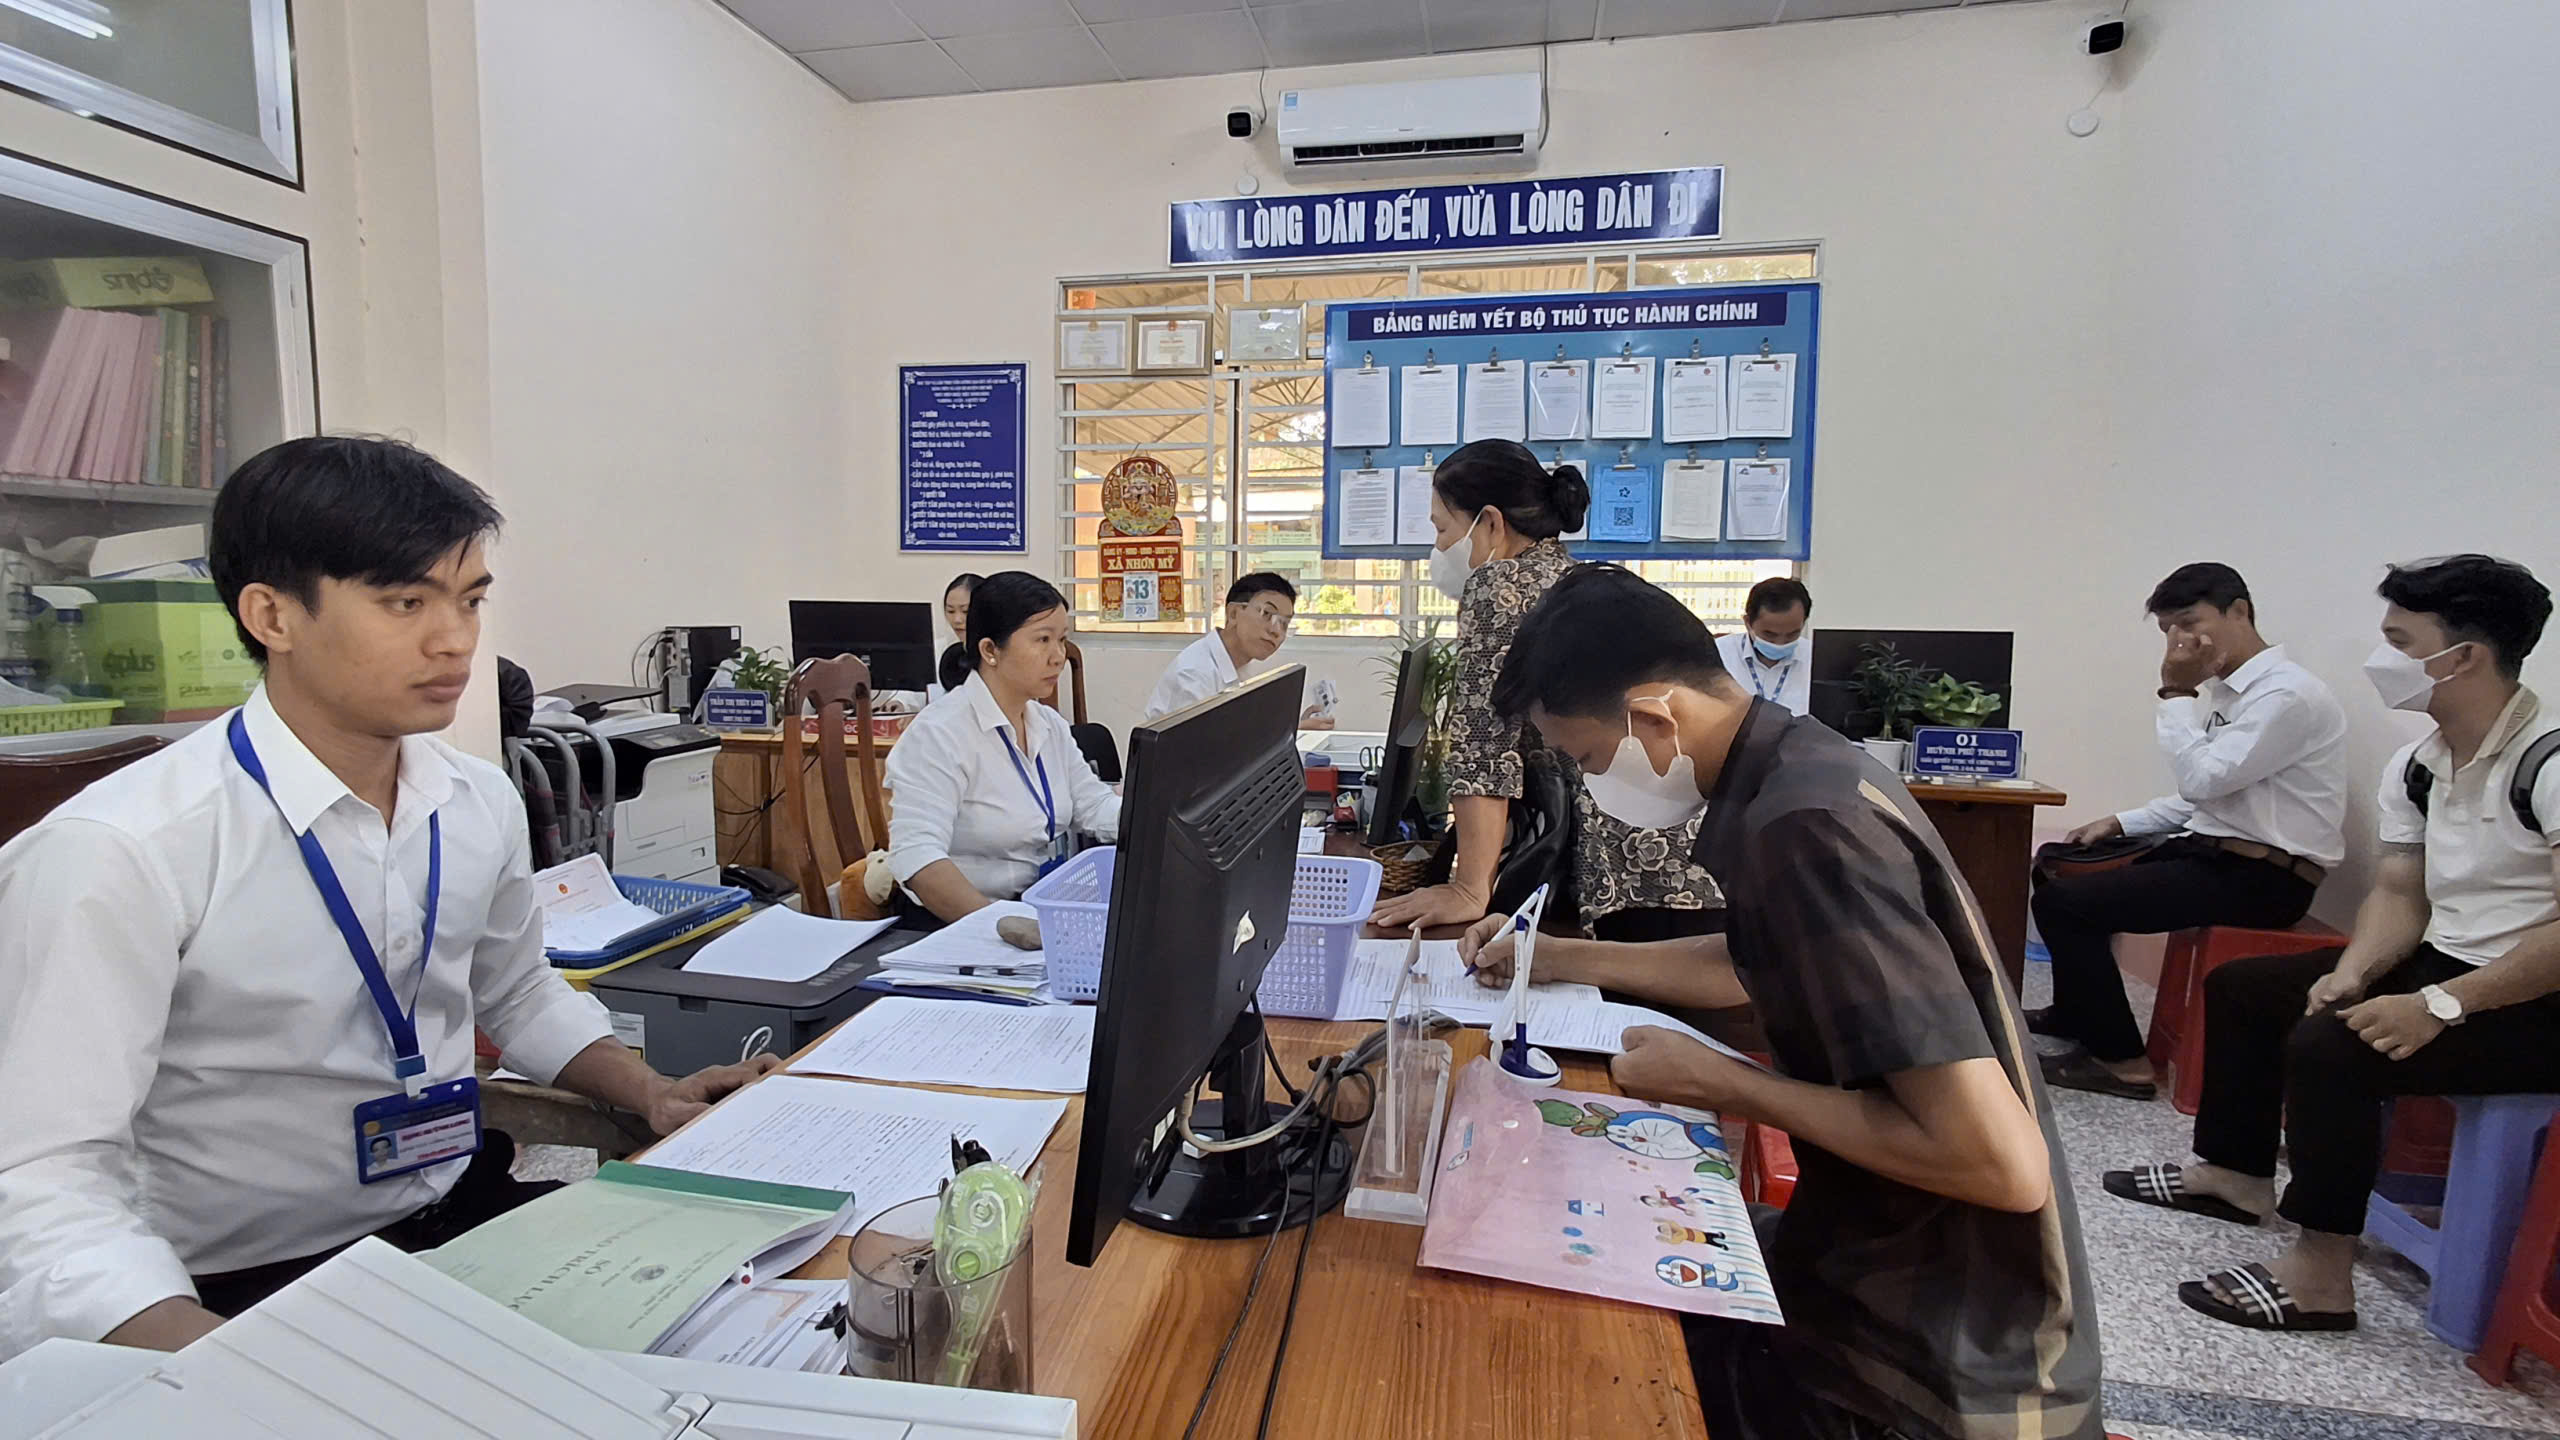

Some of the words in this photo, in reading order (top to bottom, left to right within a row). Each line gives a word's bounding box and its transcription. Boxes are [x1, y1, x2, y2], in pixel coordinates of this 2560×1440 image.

[1186, 209, 1226, 252] VUI
[1237, 200, 1303, 249] LÒNG
[1315, 198, 1366, 245] DÂN
[1444, 185, 1498, 237] VỪA
[1509, 182, 1584, 235] LÒNG
[1596, 180, 1653, 230] DÂN
[1668, 182, 1698, 225] ĐI
[1373, 311, 1423, 334] BẢNG
[1428, 310, 1477, 330] NIÊM
[1482, 306, 1516, 329] YẾT
[1520, 307, 1546, 330] BỘ
[1551, 304, 1587, 326] THỦ
[1592, 307, 1629, 328] TỤC
[1635, 303, 1690, 324] HÀNH
[1695, 300, 1758, 322] CHÍNH
[1133, 580, 1149, 599] 13
[1956, 734, 1978, 746] 01
